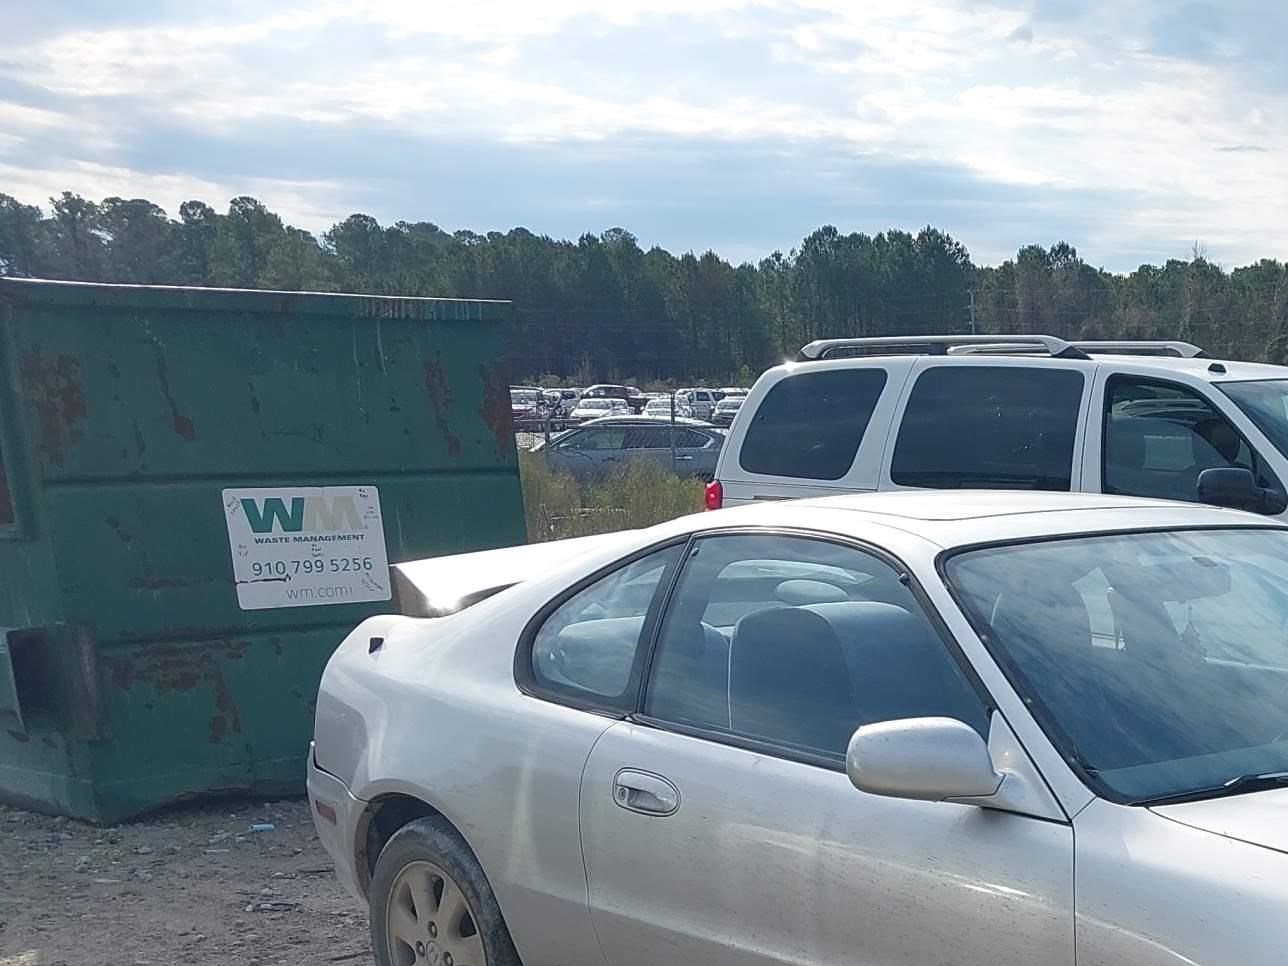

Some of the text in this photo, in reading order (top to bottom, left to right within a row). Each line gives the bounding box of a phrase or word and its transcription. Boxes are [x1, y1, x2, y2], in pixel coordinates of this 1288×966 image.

[240, 497, 364, 533] WM
[254, 534, 365, 544] WASTE MANAGEMENT
[252, 557, 373, 576] 910 799 5256
[286, 586, 348, 600] wm.com
